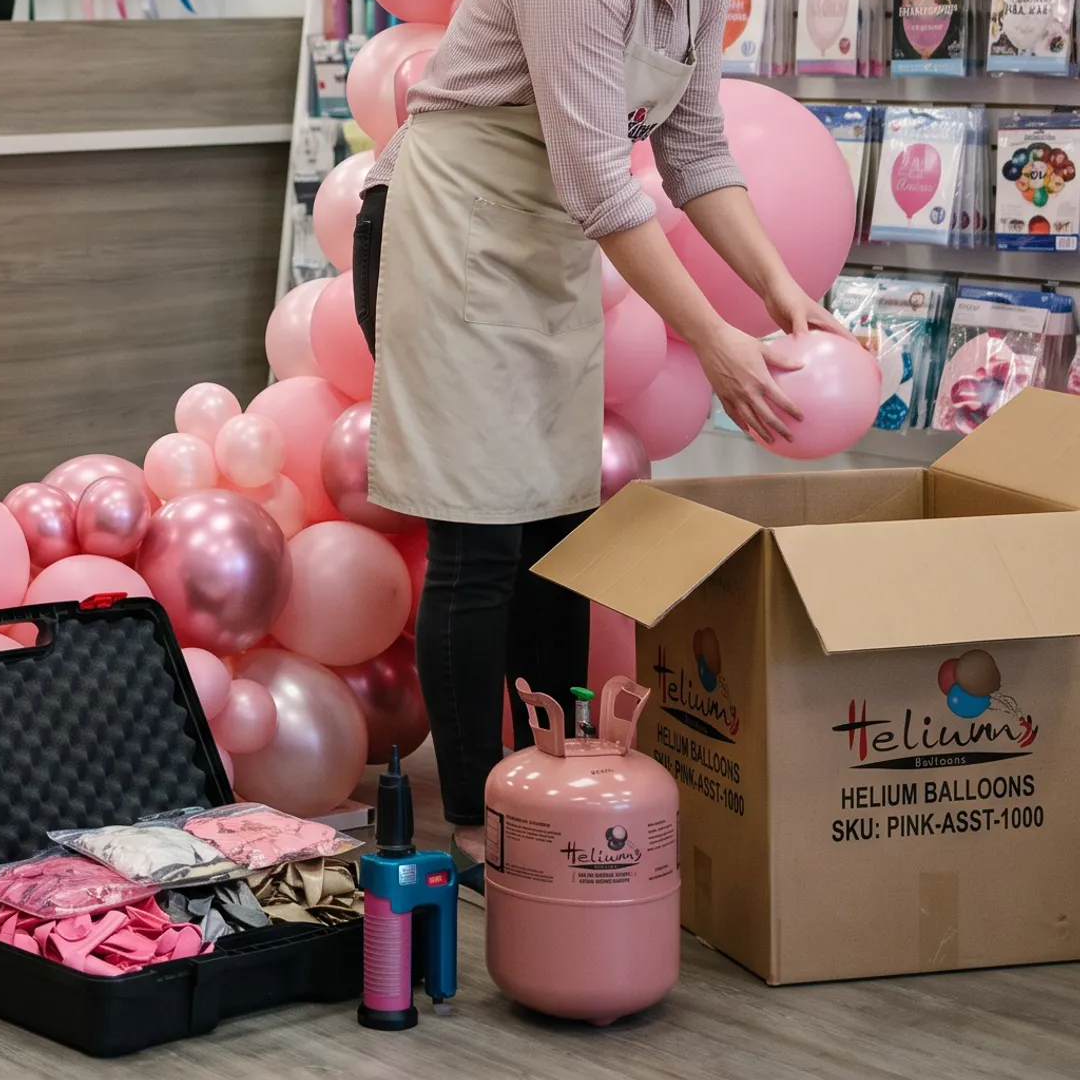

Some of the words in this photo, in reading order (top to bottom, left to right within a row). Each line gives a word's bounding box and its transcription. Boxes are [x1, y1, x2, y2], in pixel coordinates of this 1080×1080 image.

[656, 723, 689, 758] HELIUM
[690, 740, 740, 784] BALLOONS
[674, 760, 745, 817] PINK-ASST-1000
[841, 782, 917, 810] HELIUM
[924, 774, 1035, 804] BALLOONS
[831, 817, 880, 842] SKU:
[887, 805, 1045, 838] PINK-ASST-1000
